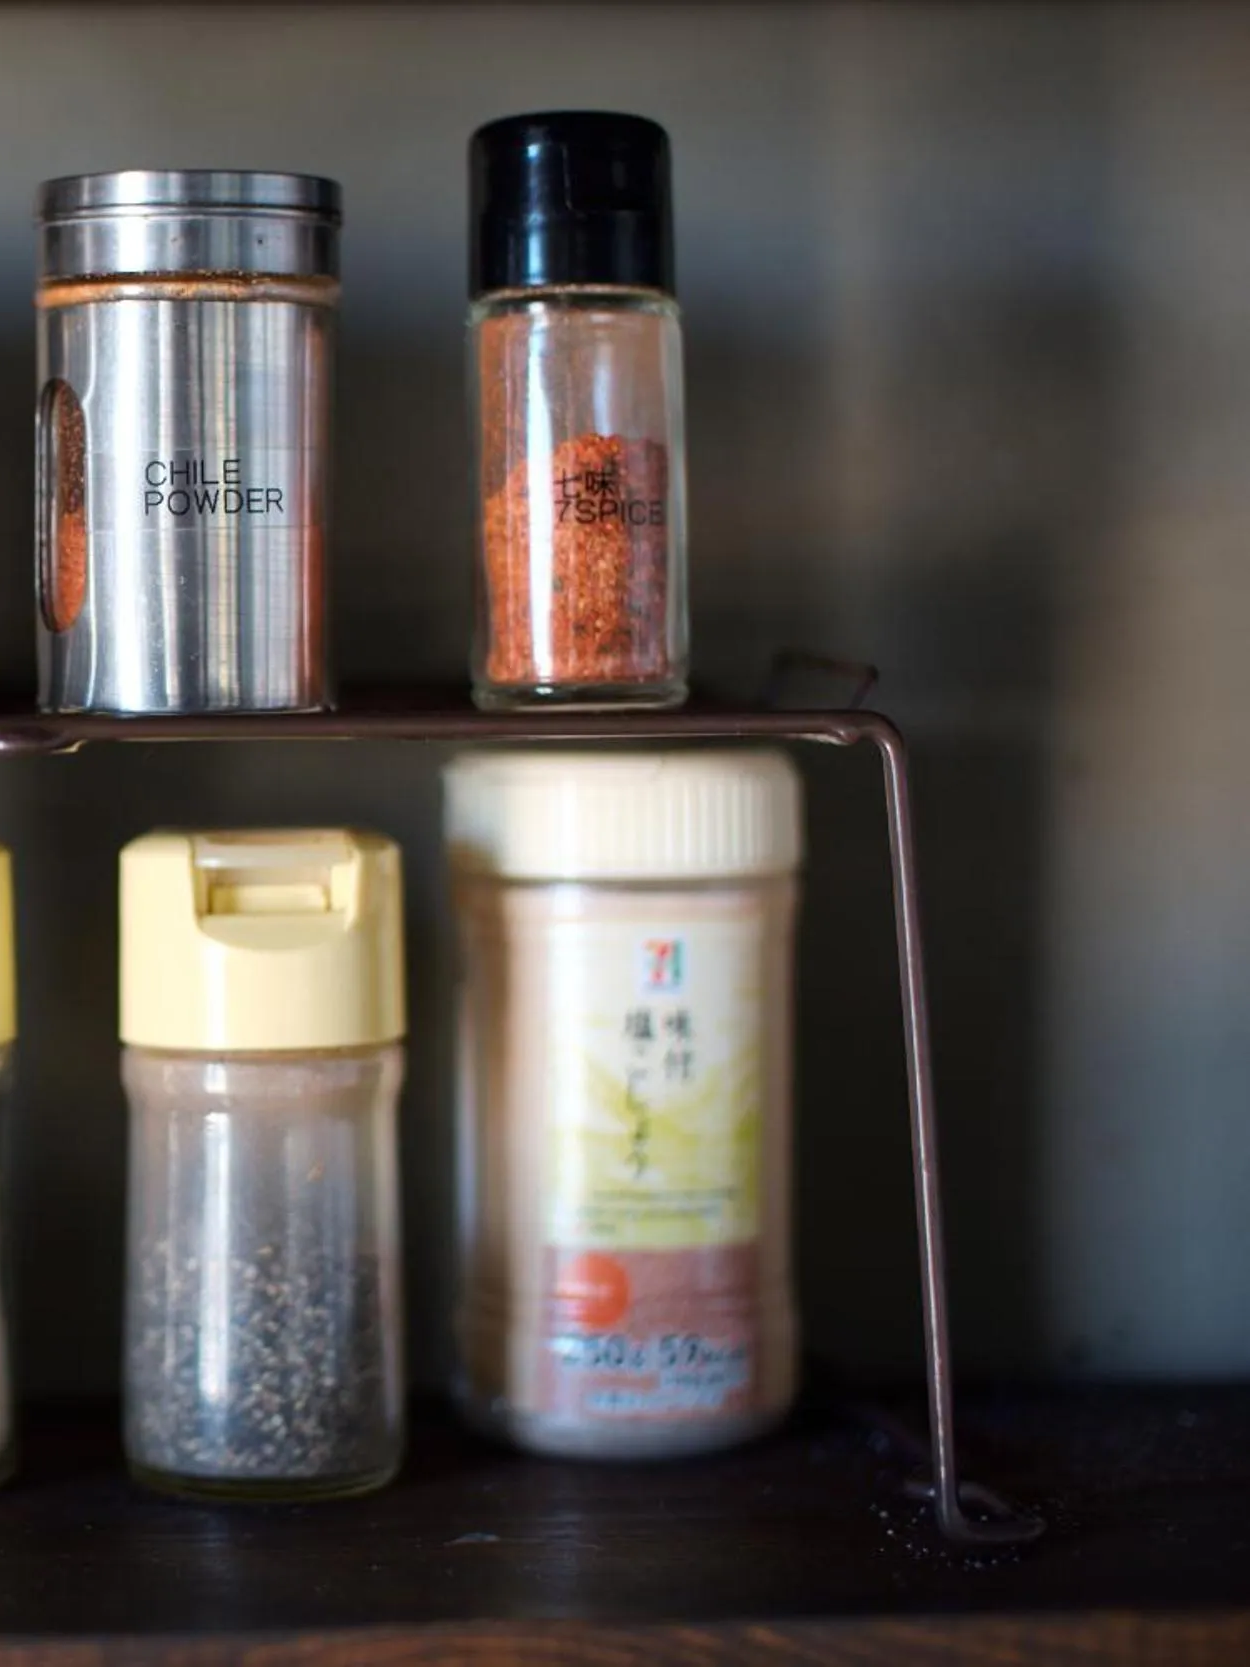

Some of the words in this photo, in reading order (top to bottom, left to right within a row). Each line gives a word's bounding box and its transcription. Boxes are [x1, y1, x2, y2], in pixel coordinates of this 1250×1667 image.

[145, 459, 241, 487] CHILE
[553, 467, 615, 499] 七味
[144, 487, 284, 516] POWDER
[554, 499, 664, 525] 7SPICE
